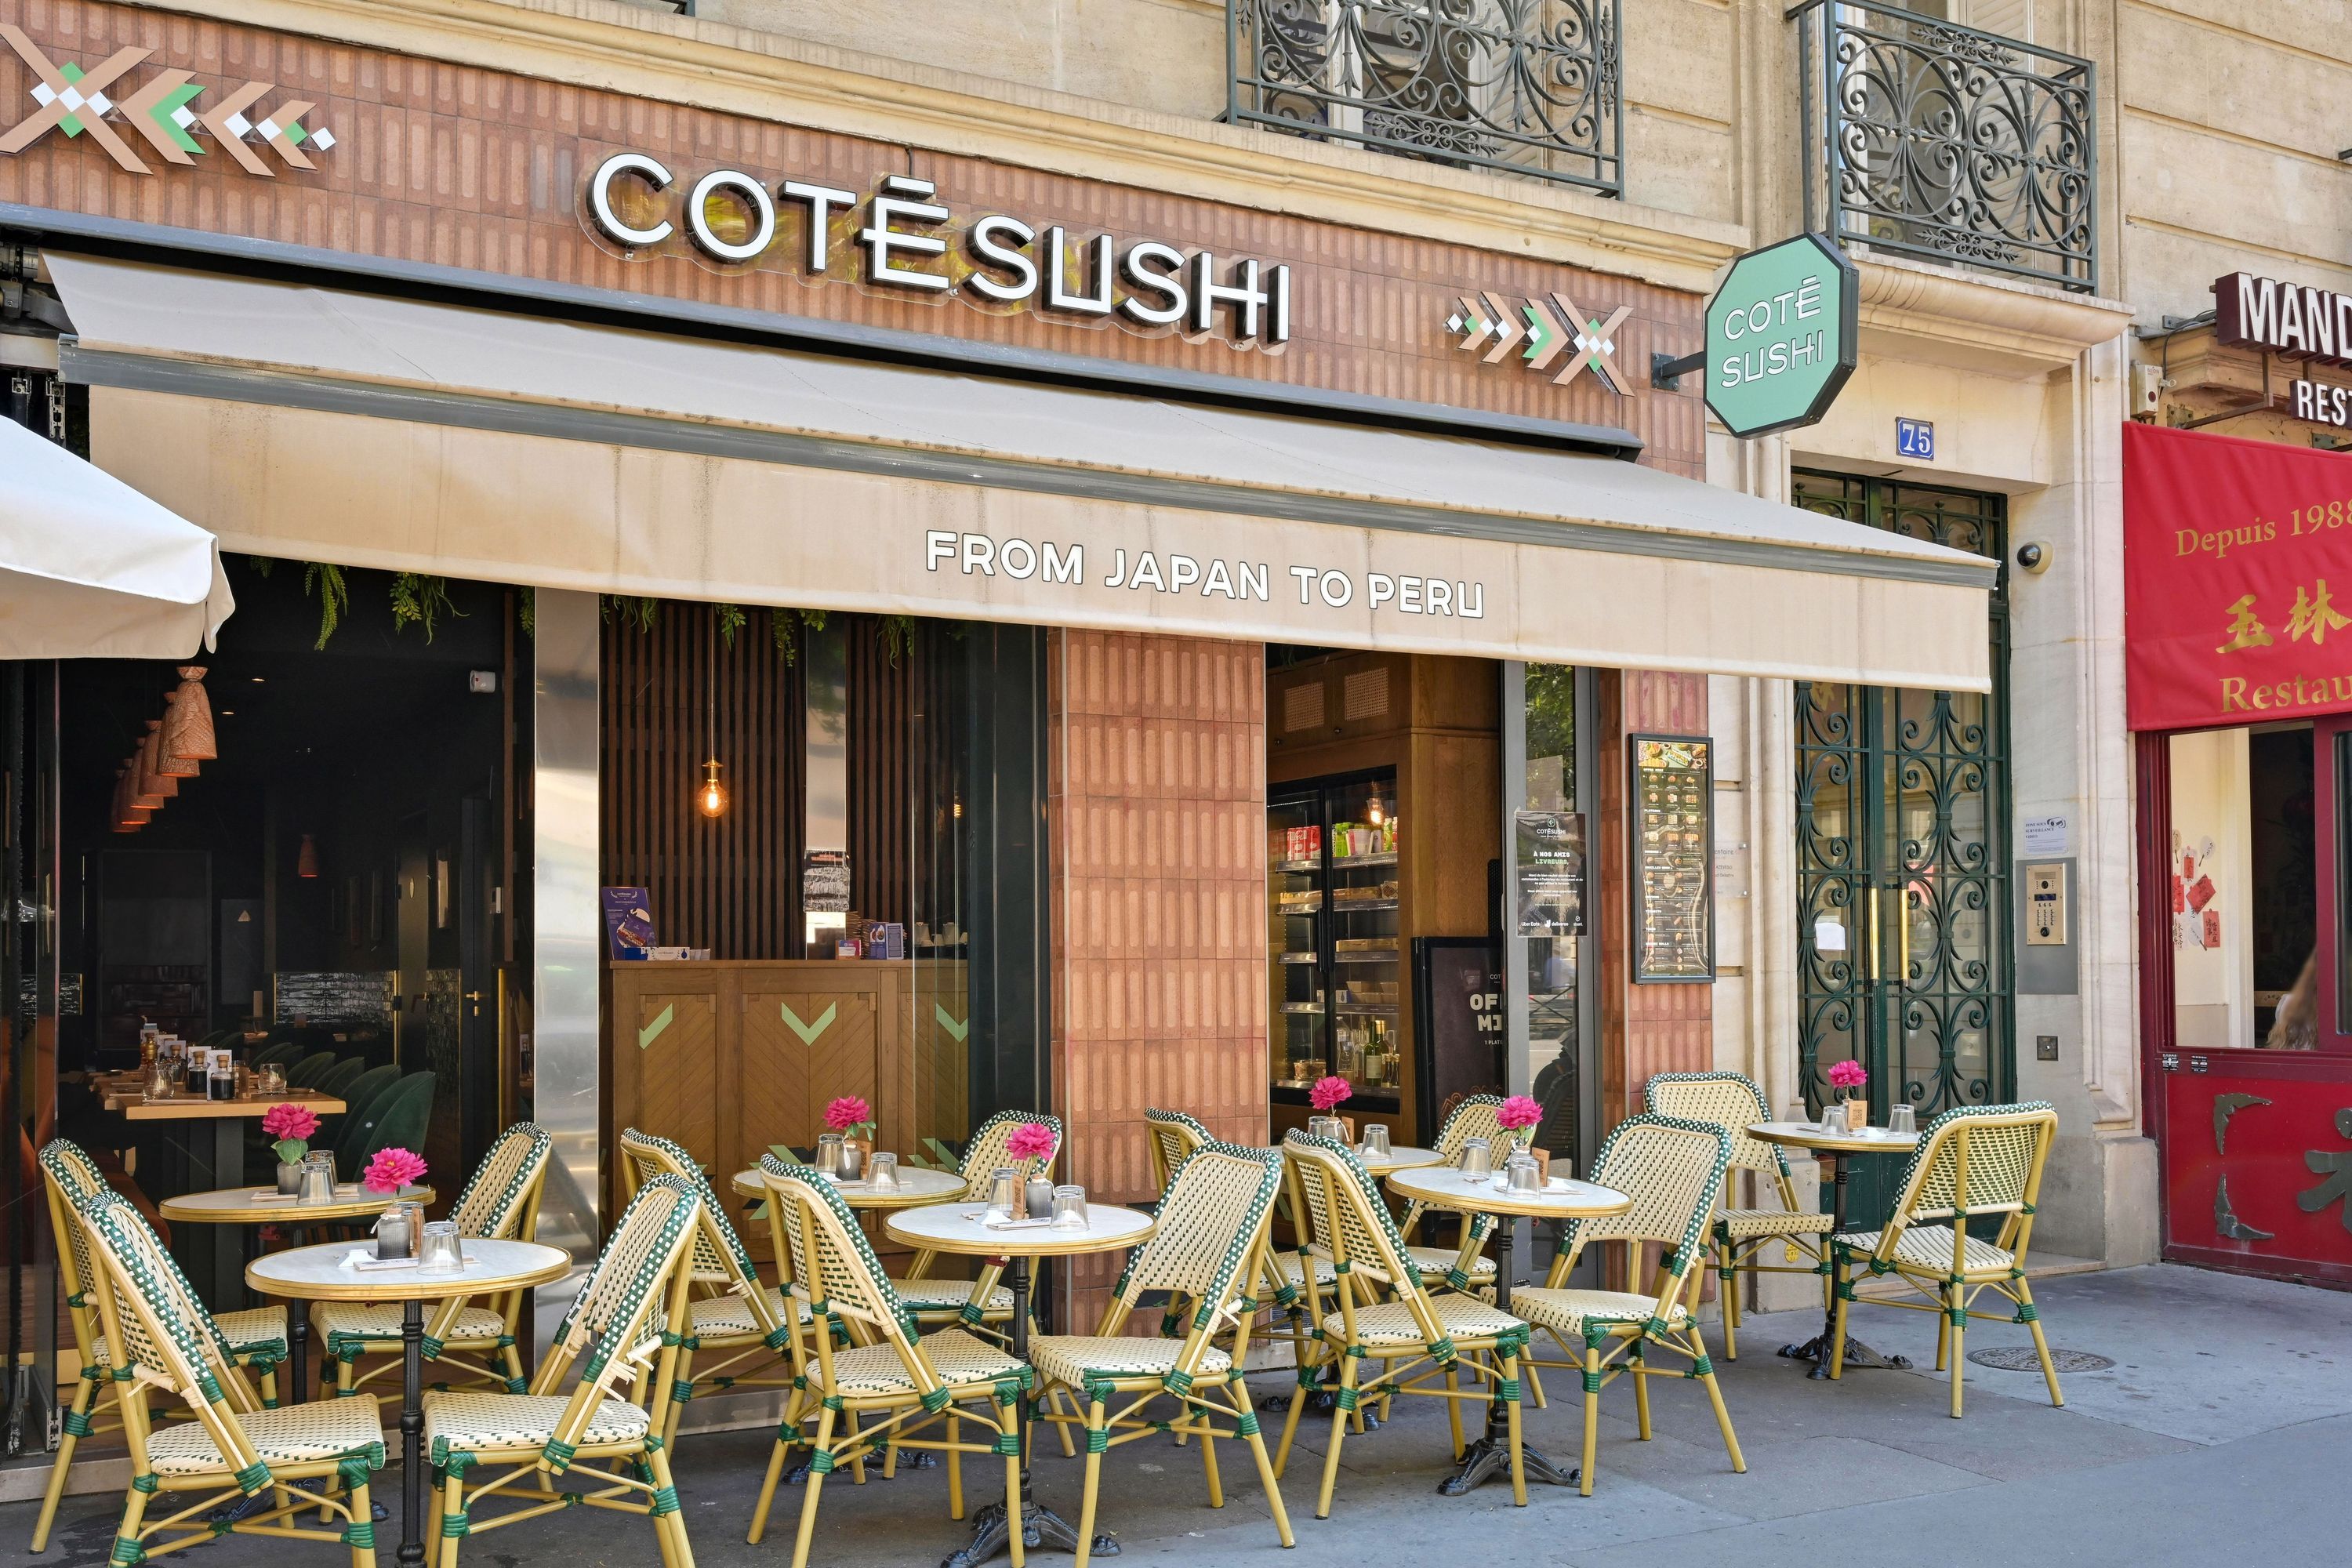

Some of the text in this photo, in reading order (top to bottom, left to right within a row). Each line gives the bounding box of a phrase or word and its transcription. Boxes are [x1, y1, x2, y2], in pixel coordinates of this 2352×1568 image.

[1721, 329, 1824, 388] SUSHI
[2296, 379, 2352, 426] RES
[1903, 423, 1931, 453] 75
[2175, 517, 2276, 559] Depuis
[926, 529, 1484, 619] FROM JAPAN TO PERU
[1469, 993, 1502, 1011] OF
